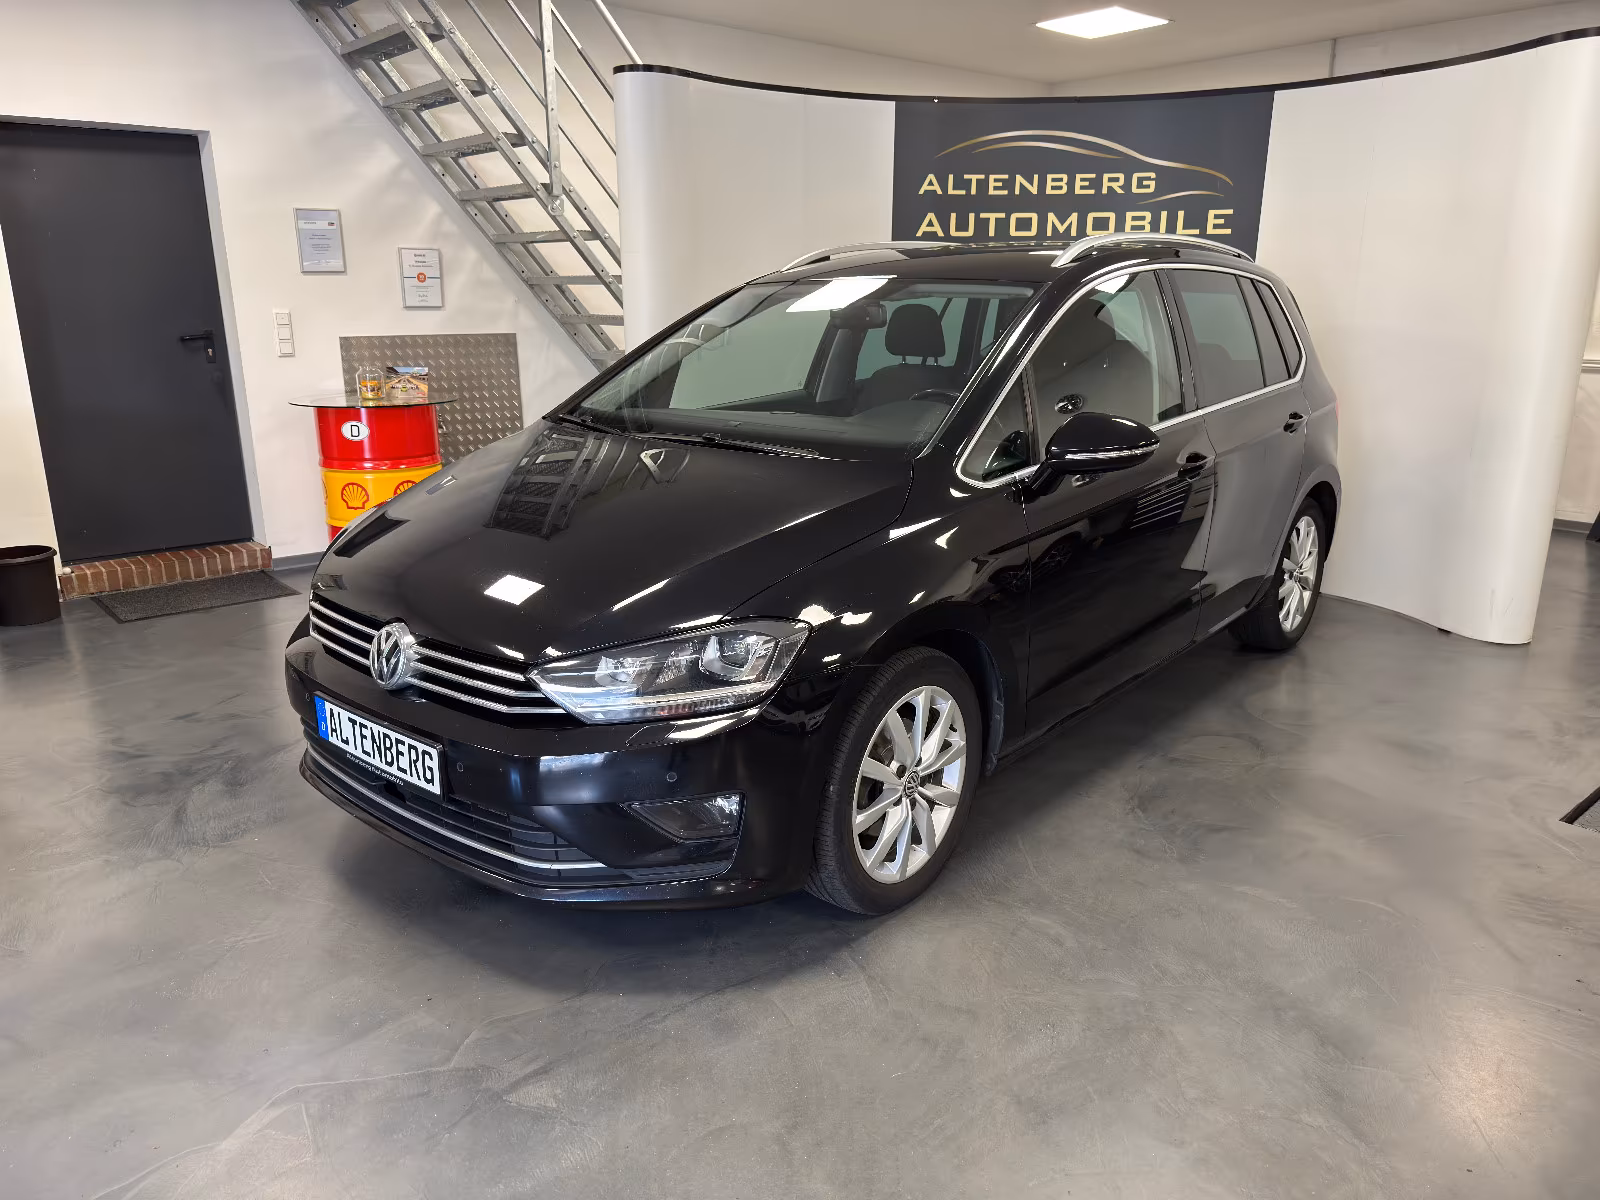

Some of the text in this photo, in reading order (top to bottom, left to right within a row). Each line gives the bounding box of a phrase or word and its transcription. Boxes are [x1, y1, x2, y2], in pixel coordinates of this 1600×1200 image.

[918, 172, 1157, 195] ALTENBERG
[915, 208, 1234, 238] AUTOMOBILE
[350, 424, 360, 438] D
[329, 707, 436, 787] ALTENBERG
